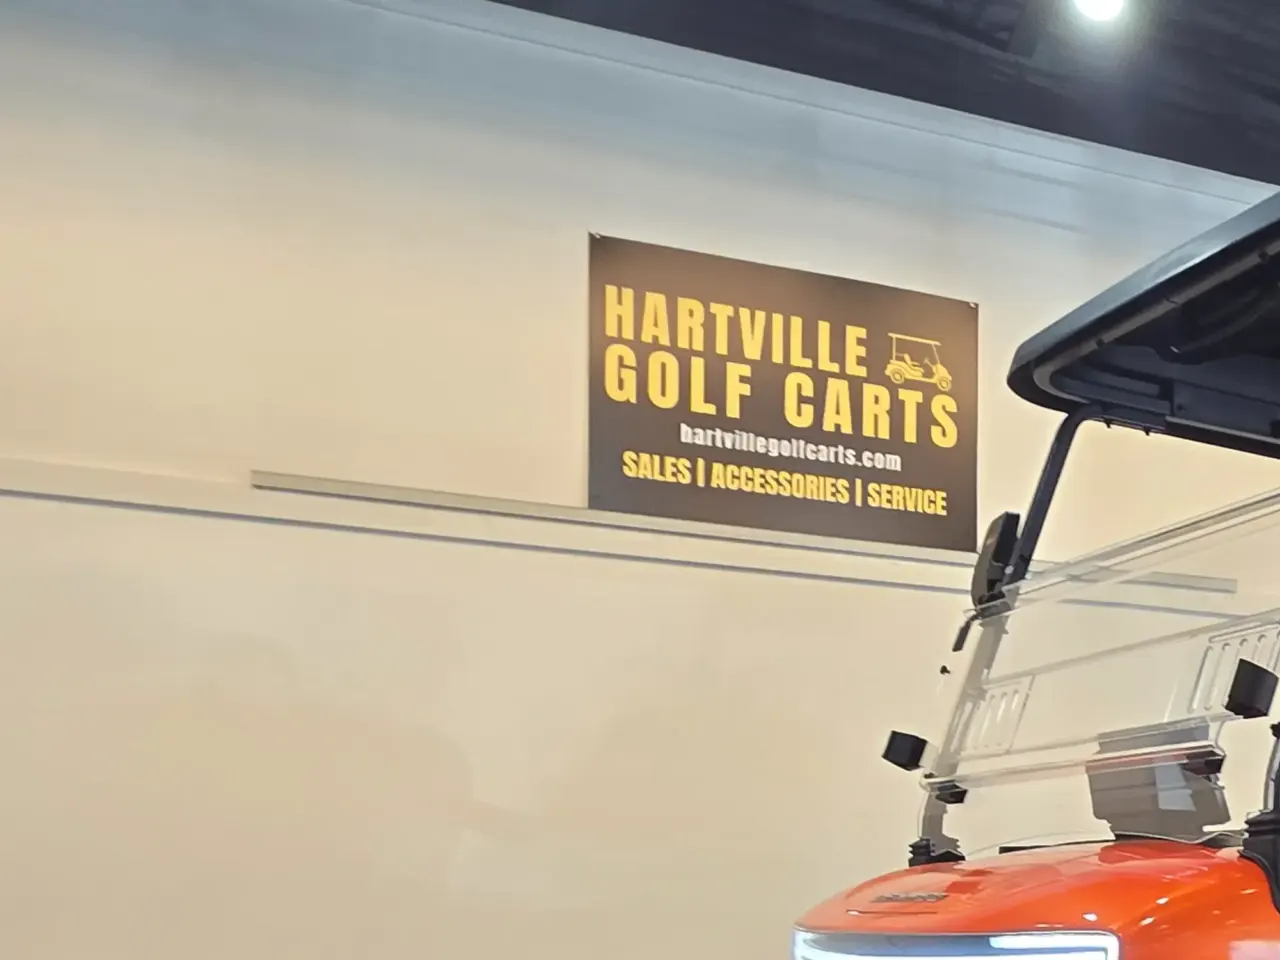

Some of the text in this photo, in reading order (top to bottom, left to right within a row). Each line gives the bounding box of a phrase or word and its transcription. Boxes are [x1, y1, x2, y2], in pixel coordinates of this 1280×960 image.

[604, 284, 868, 378] HARTVILLE
[604, 342, 959, 449] GOLF CARTS
[622, 450, 692, 485] SALES
[710, 462, 850, 505] ACCESSORIES
[867, 482, 948, 516] SERVICE
[680, 422, 902, 472] hartvillegolfcarts.com
